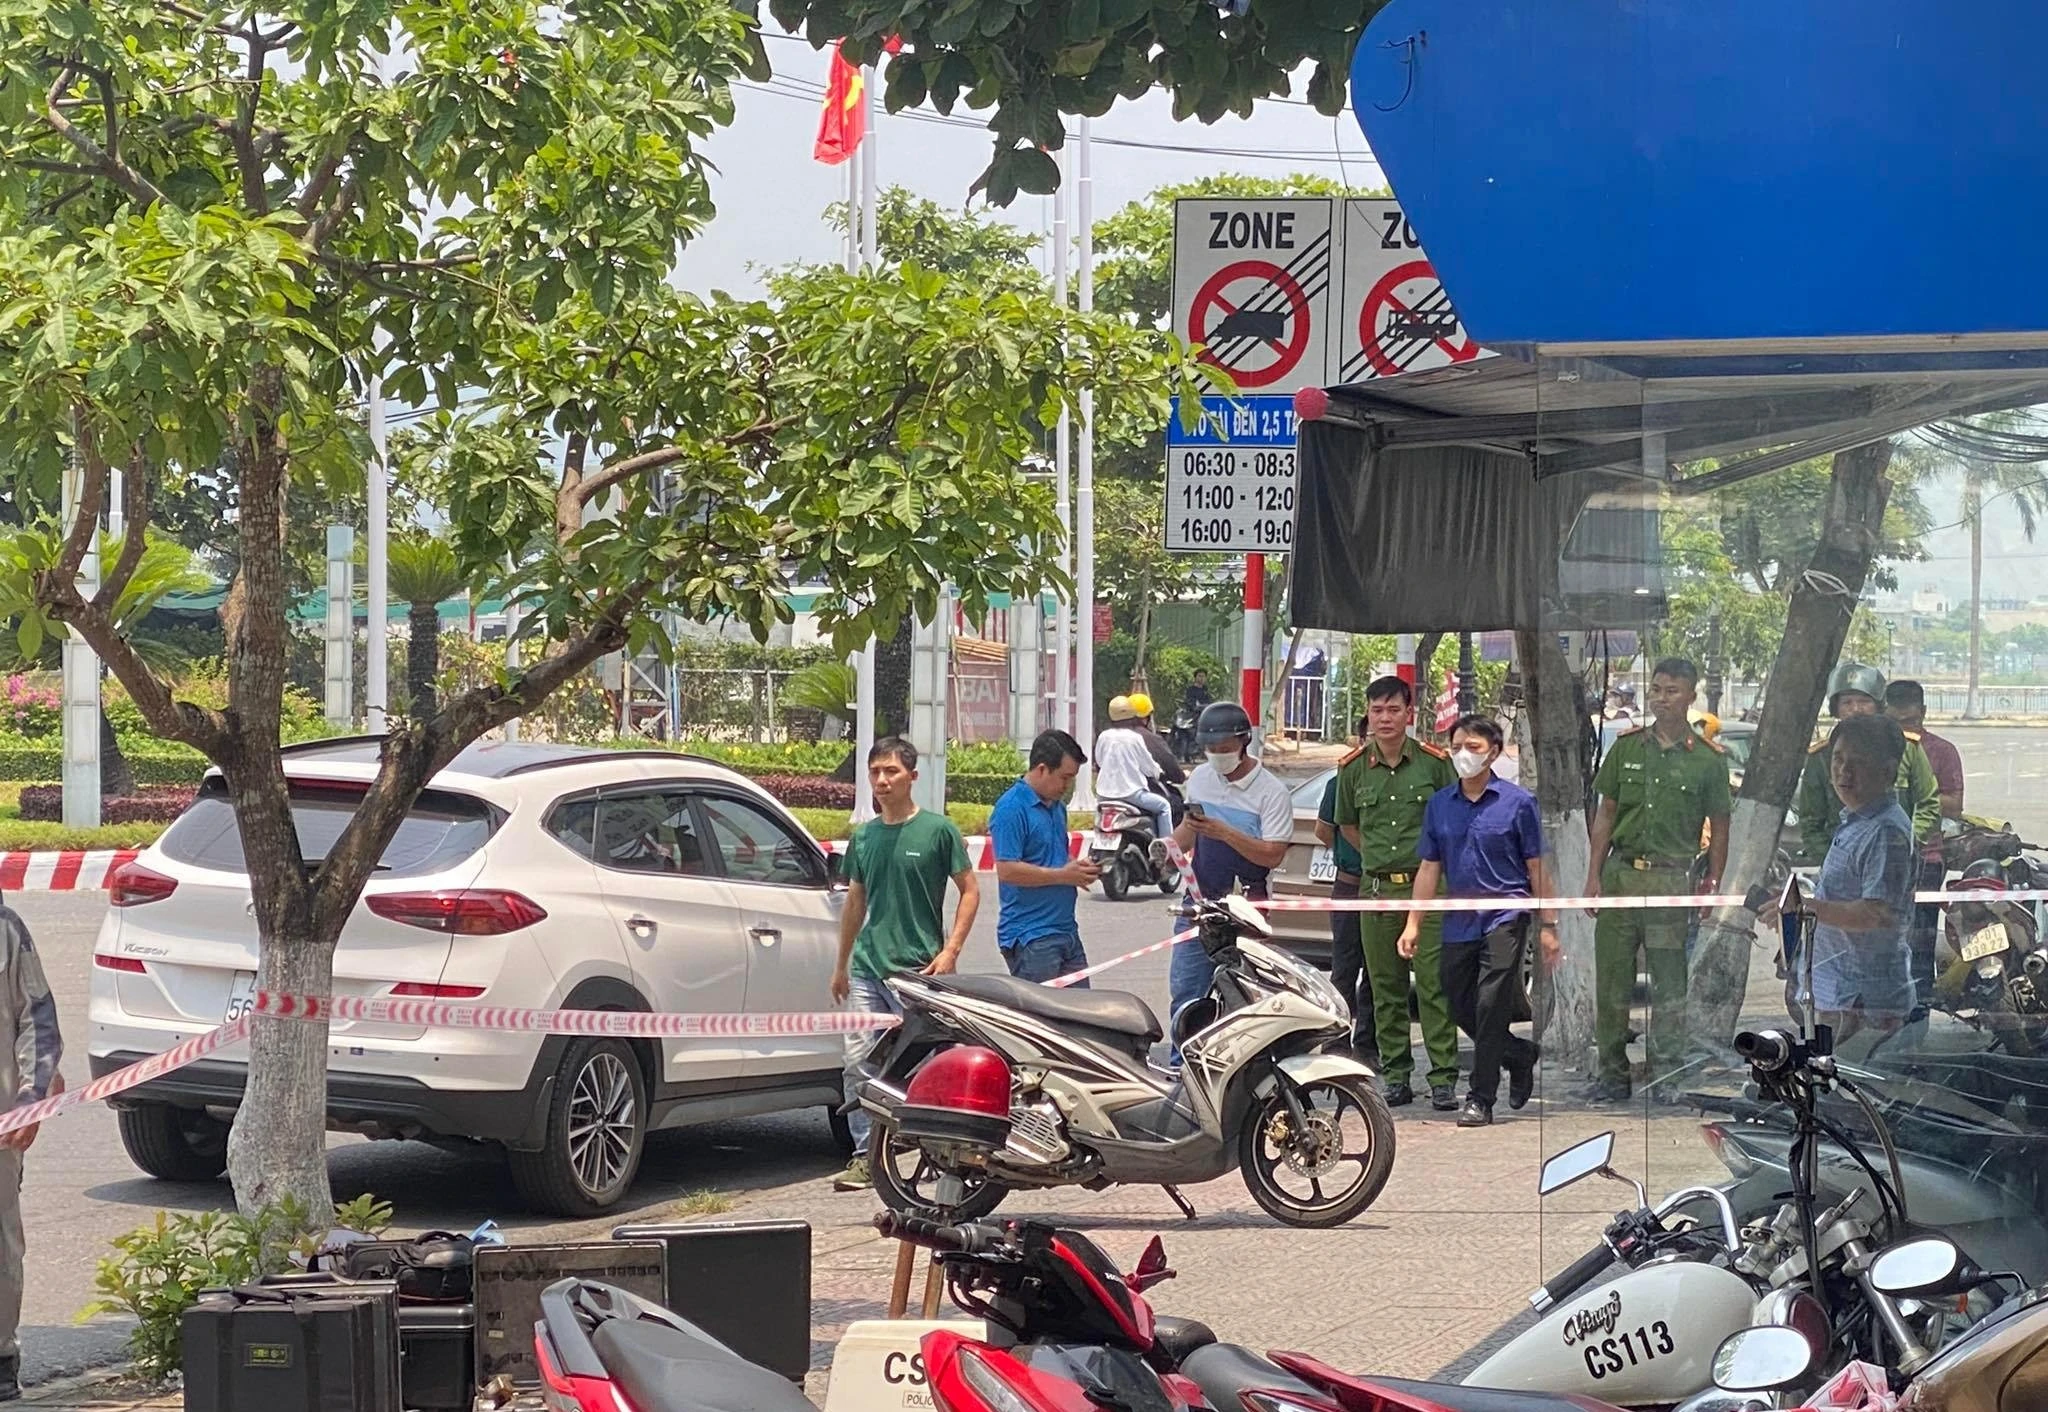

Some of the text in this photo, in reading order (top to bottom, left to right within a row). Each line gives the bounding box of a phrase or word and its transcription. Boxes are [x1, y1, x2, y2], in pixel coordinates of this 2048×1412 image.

[1209, 211, 1295, 249] ZONE
[1262, 409, 1280, 443] 2,5
[1184, 452, 1235, 477] 06:30
[1255, 452, 1295, 477] 08:3
[1183, 484, 1234, 510] 11:00
[1255, 486, 1294, 511] 12:0
[1181, 518, 1231, 543] 16:00
[1253, 519, 1292, 544] 19:0
[1584, 1320, 1675, 1380] CS113
[884, 1351, 927, 1386] CS
